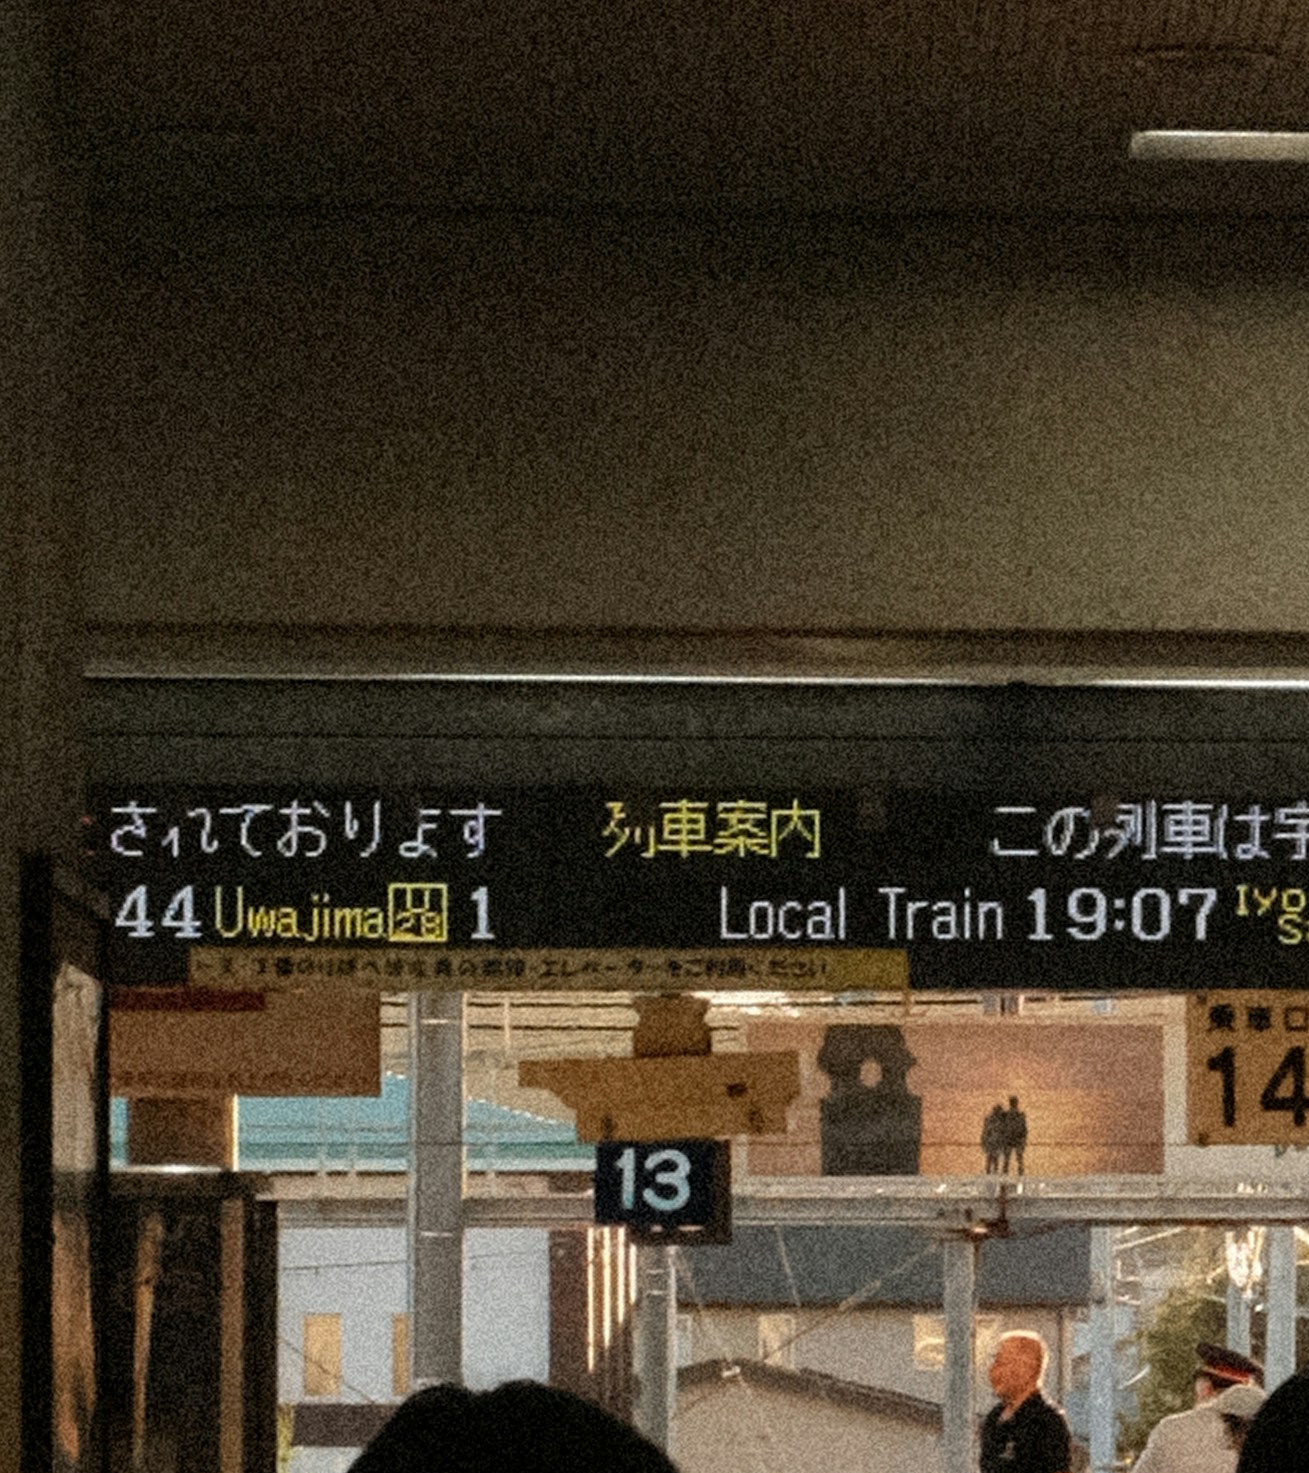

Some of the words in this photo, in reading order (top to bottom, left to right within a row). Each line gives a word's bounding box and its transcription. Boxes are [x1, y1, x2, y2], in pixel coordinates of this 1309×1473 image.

[602, 799, 821, 859] 列車案内
[114, 884, 203, 939] 44
[214, 885, 387, 942] Uwajima
[470, 885, 496, 940] 1
[720, 885, 847, 940] Local
[878, 886, 1004, 940] Train
[1027, 886, 1219, 942] 19:07
[615, 1146, 692, 1212] 13
